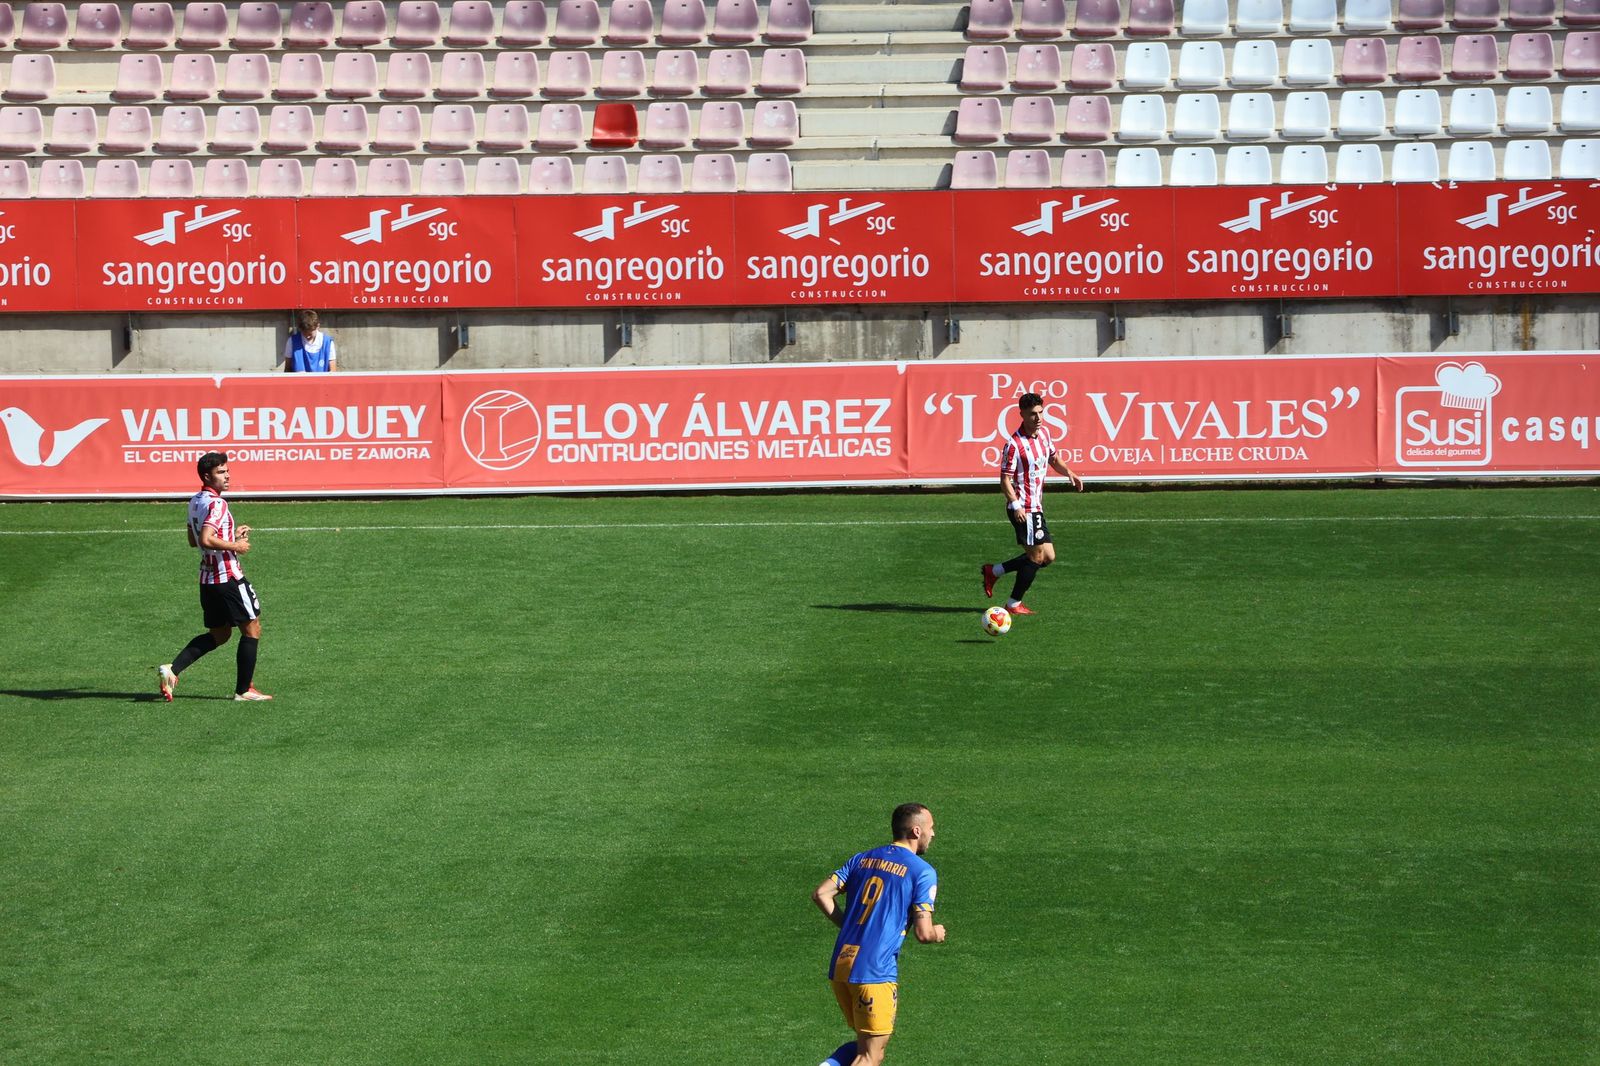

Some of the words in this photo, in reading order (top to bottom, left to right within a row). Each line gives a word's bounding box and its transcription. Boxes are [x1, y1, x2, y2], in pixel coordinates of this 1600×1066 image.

[1100, 212, 1129, 233] sgc
[1309, 208, 1338, 229] sgc
[1547, 205, 1577, 225] sgc
[0, 224, 16, 244] gc
[222, 222, 252, 244] sgc
[428, 221, 457, 242] sgc
[661, 218, 690, 239] sgc
[866, 216, 895, 236] sgc
[542, 248, 724, 290] sangregorio
[747, 246, 929, 287] sangregorio
[980, 243, 1163, 284] sangregorio
[1187, 240, 1373, 281] sangregorio
[102, 254, 286, 294] sangregorio
[309, 253, 492, 292] sangregorio
[791, 289, 886, 299] CONSTRUCCION
[1024, 286, 1120, 296] CONSTRUCCION
[1231, 283, 1328, 293] CONSTRUCCION
[1469, 280, 1568, 290] CONSTRUCCION
[147, 296, 243, 306] CONSTRUCCION
[353, 295, 448, 305] CONSTRUCCION
[586, 292, 681, 302] CONSTRUCCION
[121, 405, 426, 441] VALDERADUEY
[546, 402, 669, 440] ELOY
[682, 392, 892, 438] ÁLVAREZ
[1405, 410, 1482, 446] Susi
[1501, 415, 1600, 449] casq
[124, 450, 146, 463] EL
[149, 449, 218, 463] CENTR
[226, 447, 326, 463] COMERCIAL
[331, 447, 353, 461] DE
[357, 446, 431, 461] ZAMORA
[546, 440, 751, 464] CONTRUCCIONES
[757, 435, 892, 461] METÁLICAS
[1171, 445, 1234, 462] LECHE
[1239, 445, 1309, 461] CRUDA
[1406, 448, 1434, 456] delicias
[1435, 448, 1447, 456] del
[1447, 448, 1482, 457] gourmet
[1036, 515, 1042, 529] 3
[856, 876, 885, 925] 9
